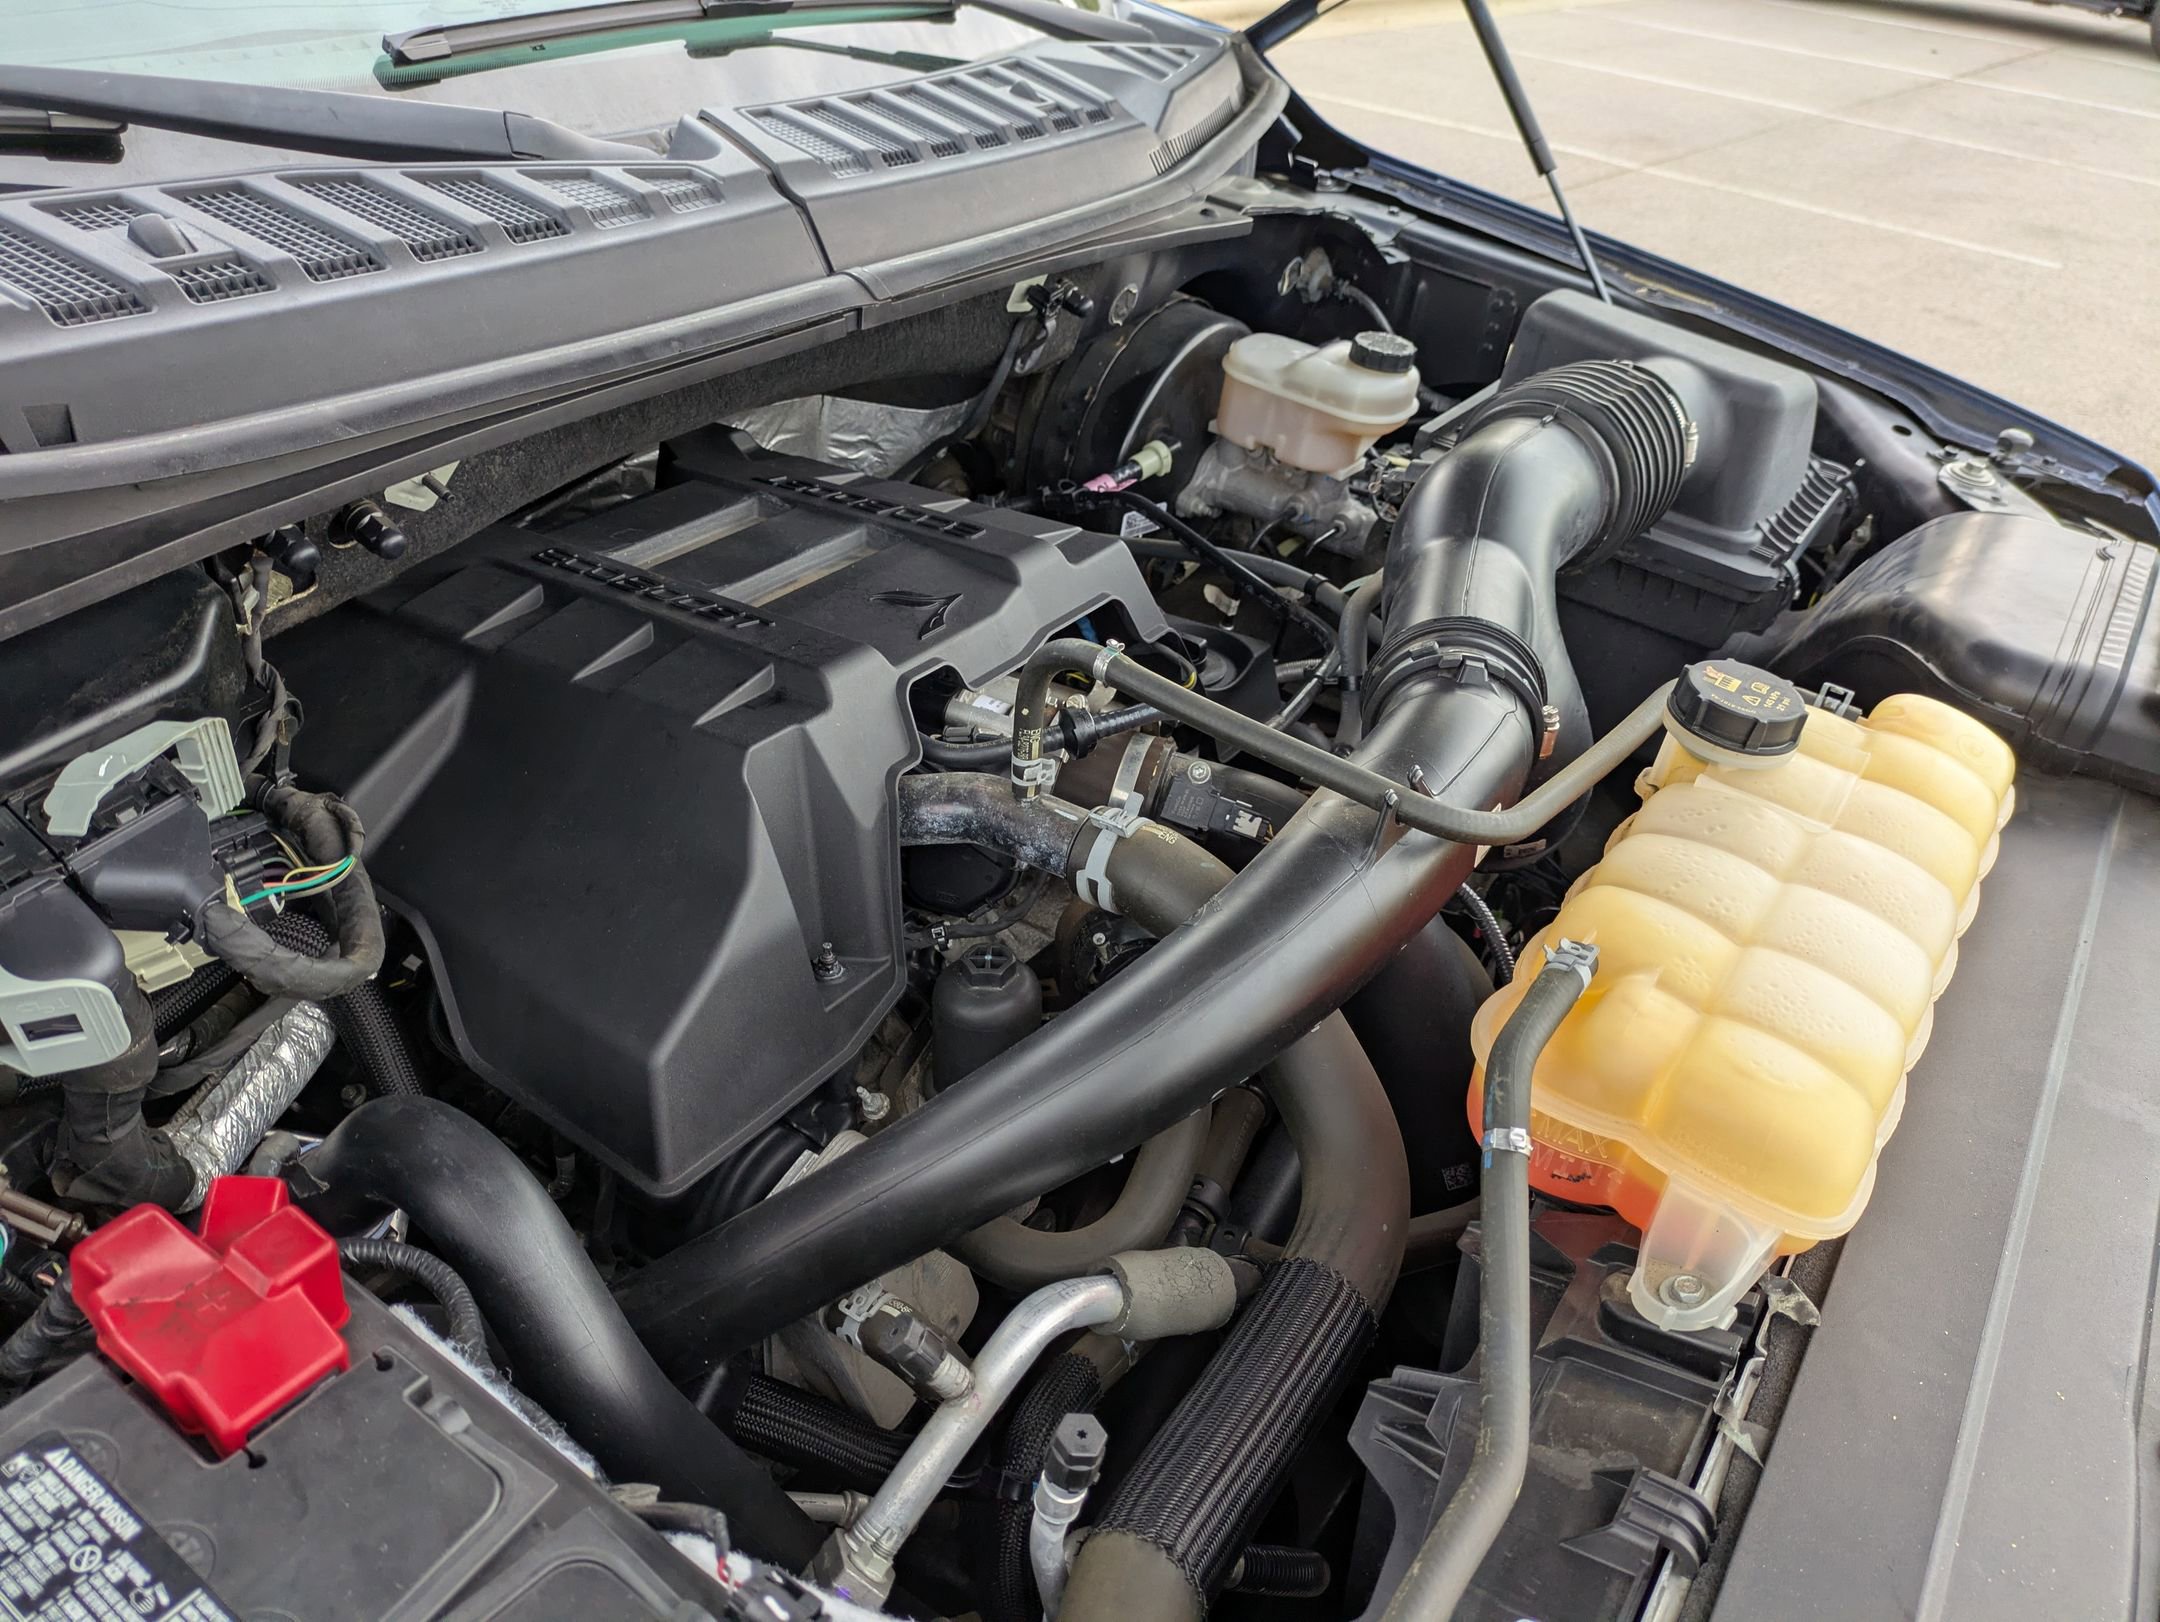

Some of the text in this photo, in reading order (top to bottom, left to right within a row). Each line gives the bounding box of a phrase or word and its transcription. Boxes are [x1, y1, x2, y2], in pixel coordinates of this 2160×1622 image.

[531, 546, 777, 628] ECOBOOST
[1157, 830, 1178, 845] ENG
[1536, 1118, 1607, 1159] MAX
[1529, 1142, 1604, 1186] MIN
